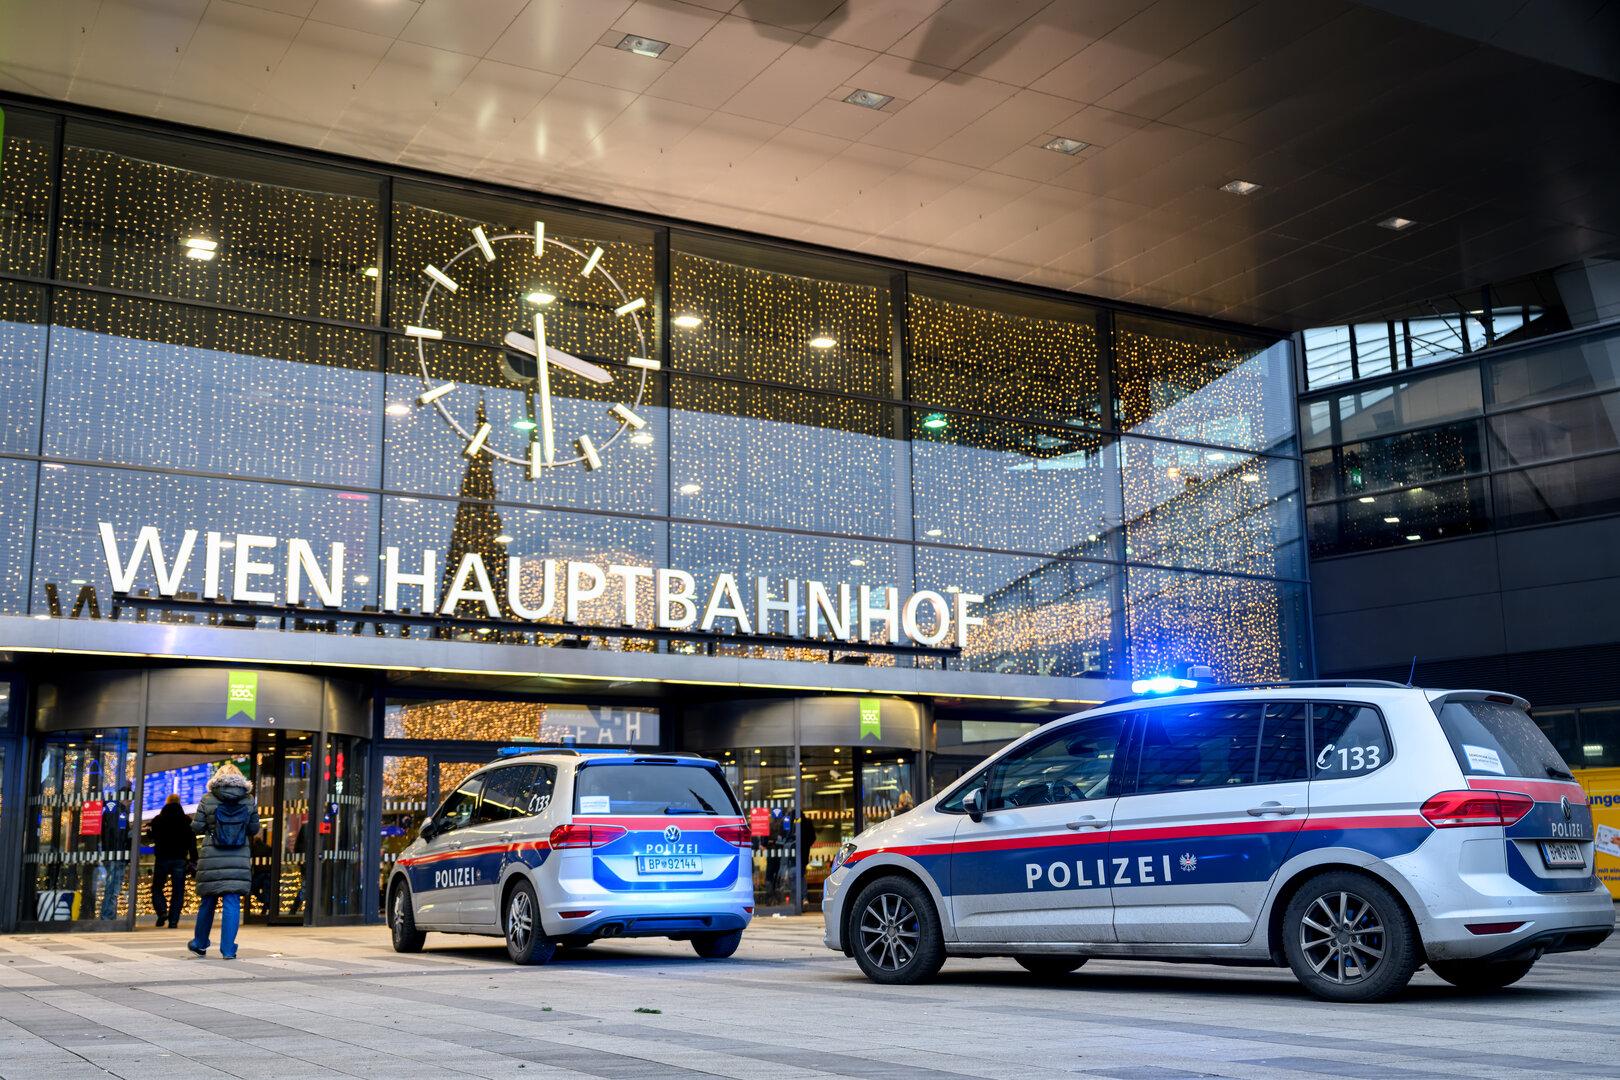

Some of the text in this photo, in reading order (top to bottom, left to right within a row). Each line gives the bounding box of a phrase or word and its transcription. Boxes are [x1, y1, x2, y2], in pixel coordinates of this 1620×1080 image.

[98, 522, 345, 607] WIEN
[384, 546, 985, 648] HAUPTBAHNHOF
[1338, 745, 1381, 771] 133
[535, 795, 550, 812] 133
[1550, 822, 1584, 838] POLIZEI
[645, 843, 698, 855] POLIZEI
[435, 866, 475, 888] POLIZEI
[1025, 854, 1173, 890] POLIZEI
